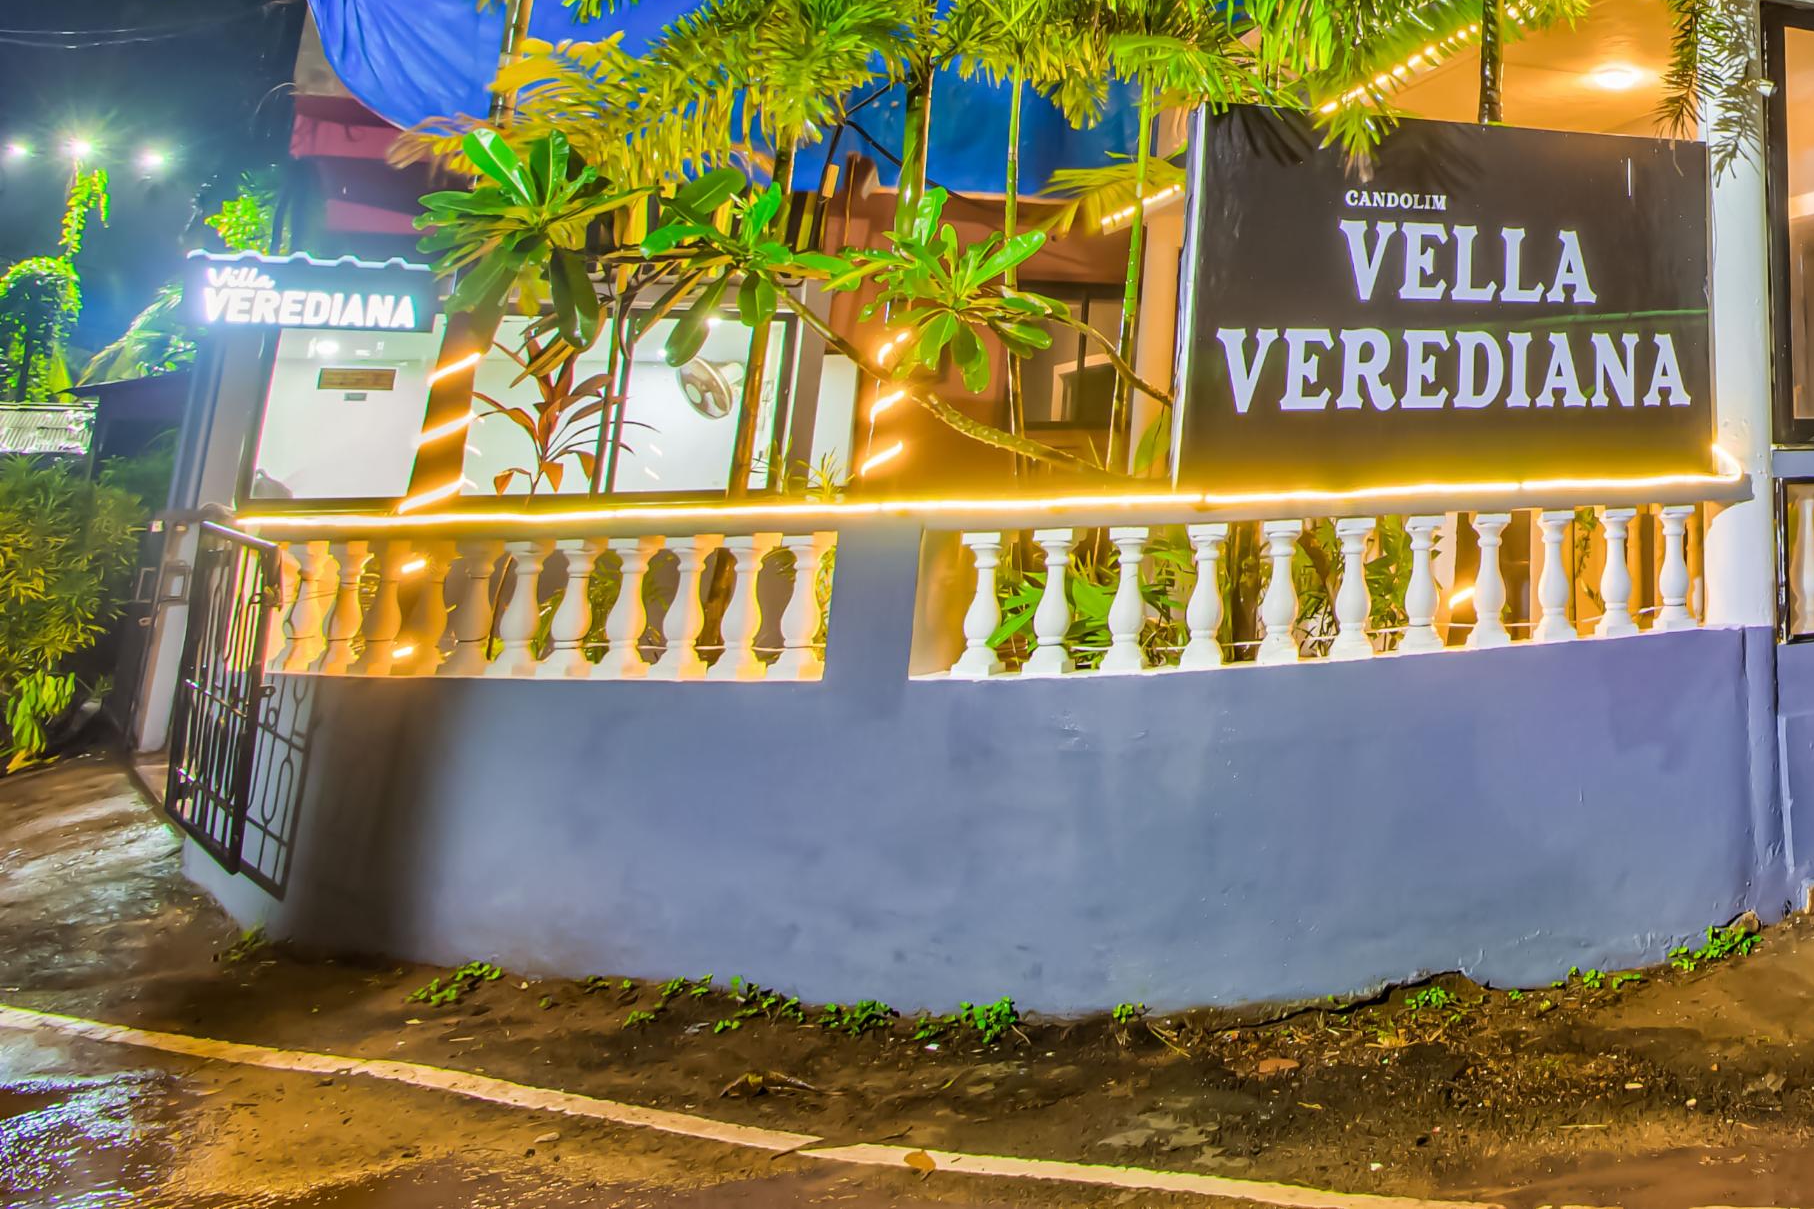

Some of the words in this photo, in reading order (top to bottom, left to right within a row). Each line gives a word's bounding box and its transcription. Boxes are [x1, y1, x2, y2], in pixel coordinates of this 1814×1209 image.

[1345, 189, 1447, 211] CANDOLIM
[207, 266, 276, 289] Villa
[1339, 219, 1598, 304] VELLA
[204, 288, 416, 329] VEREDIANA
[1216, 327, 1692, 414] VEREDIANA
